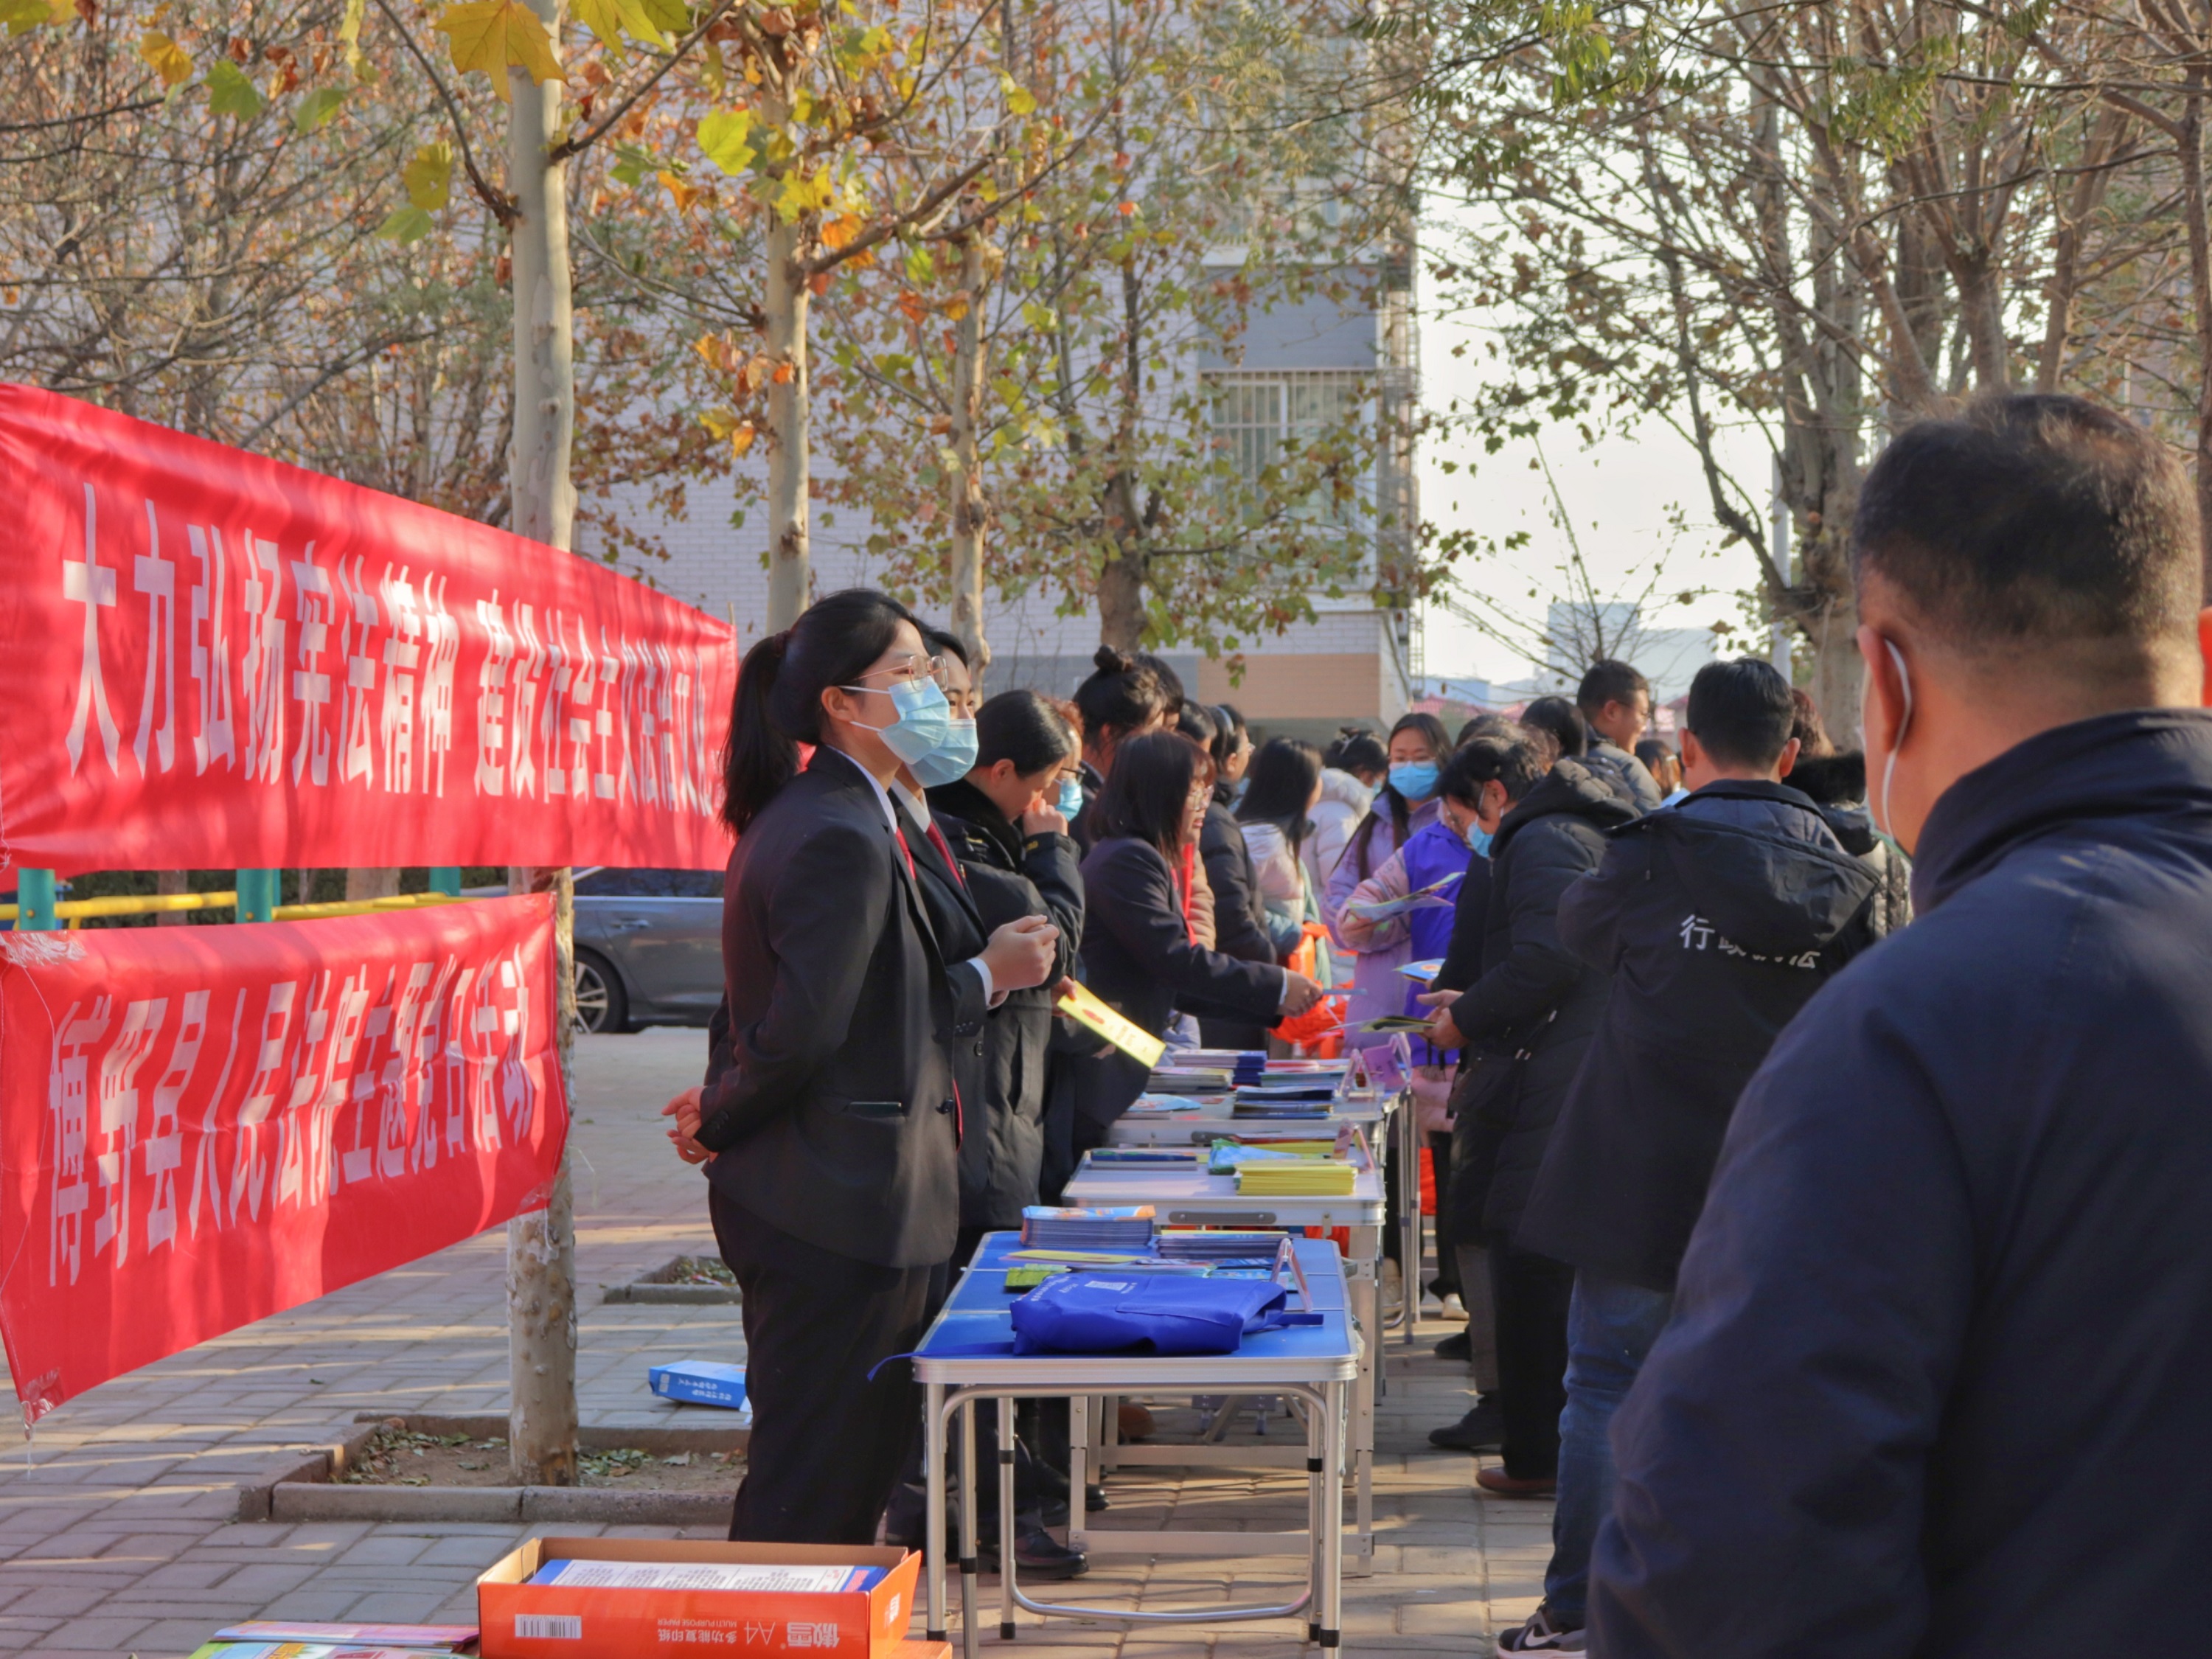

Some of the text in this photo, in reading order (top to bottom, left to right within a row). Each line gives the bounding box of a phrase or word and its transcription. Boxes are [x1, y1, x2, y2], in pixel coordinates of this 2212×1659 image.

[63, 482, 714, 816] 大力弘扬宪法精神 建设社会主义法治文化
[49, 942, 534, 1287] 博野县人民法院主题党日活动
[657, 1618, 737, 1628] MULTI PURPOSE PAPER
[744, 1621, 776, 1645] A4
[787, 1622, 840, 1649] 傲雪
[657, 1628, 737, 1644] 多功能复印纸
